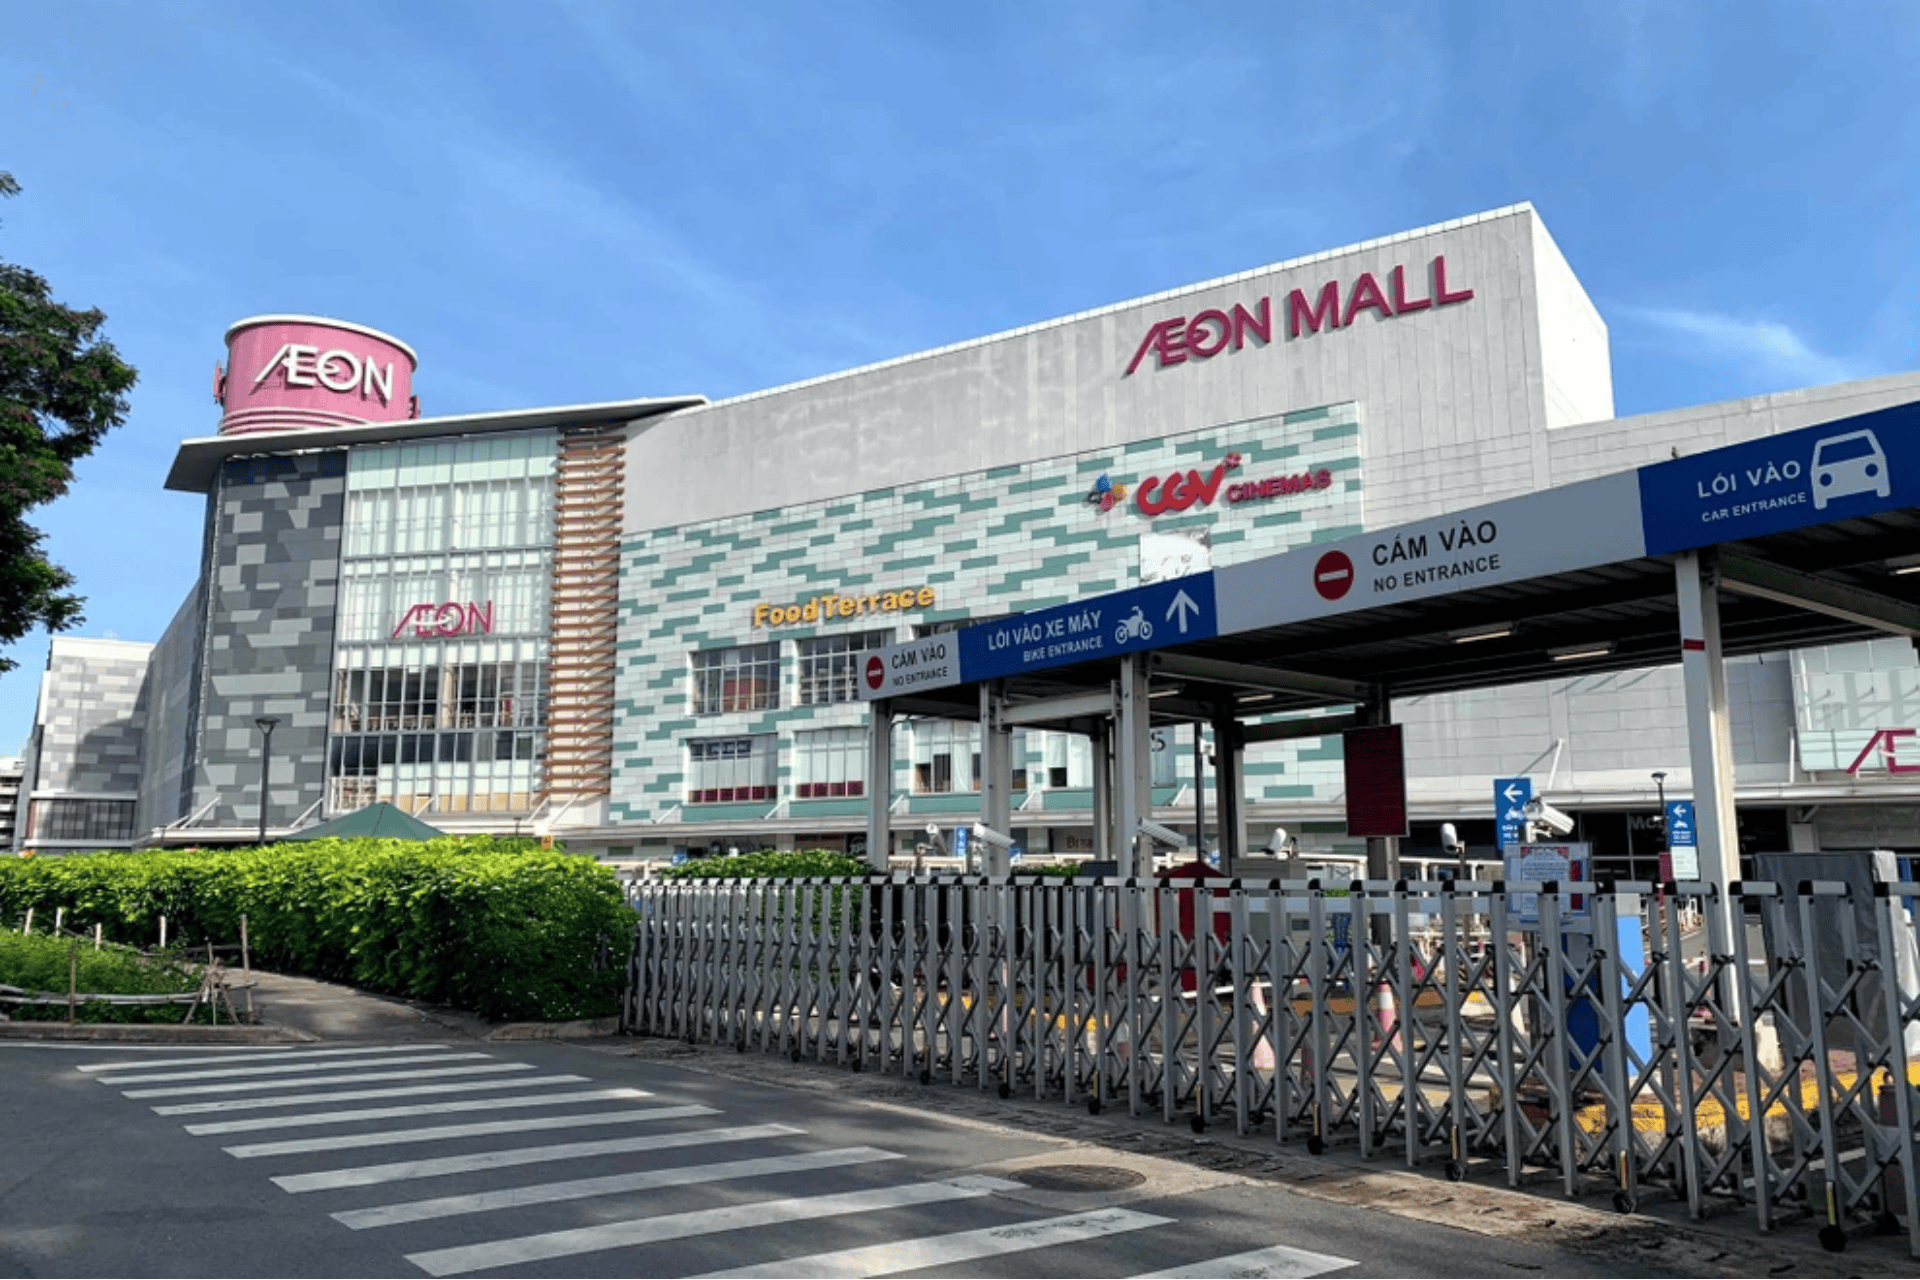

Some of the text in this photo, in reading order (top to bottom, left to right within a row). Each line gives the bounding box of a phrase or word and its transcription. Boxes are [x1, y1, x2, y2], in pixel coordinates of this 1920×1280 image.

[1289, 254, 1475, 338] MALL
[1746, 460, 1801, 487] VÀO
[1136, 463, 1333, 516] CGV CINEMAS
[1701, 491, 1807, 522] CAR ENTRANCE
[1438, 519, 1497, 551] VÀO
[1373, 553, 1500, 592] NO ENTRANCE
[1012, 622, 1043, 645] VÀO
[1045, 618, 1065, 638] XE
[1067, 609, 1103, 634] MÁY
[922, 641, 946, 663] VÀO
[1023, 635, 1104, 663] BIKE ENTRANCE
[892, 665, 948, 687] NO ENTRANCE
